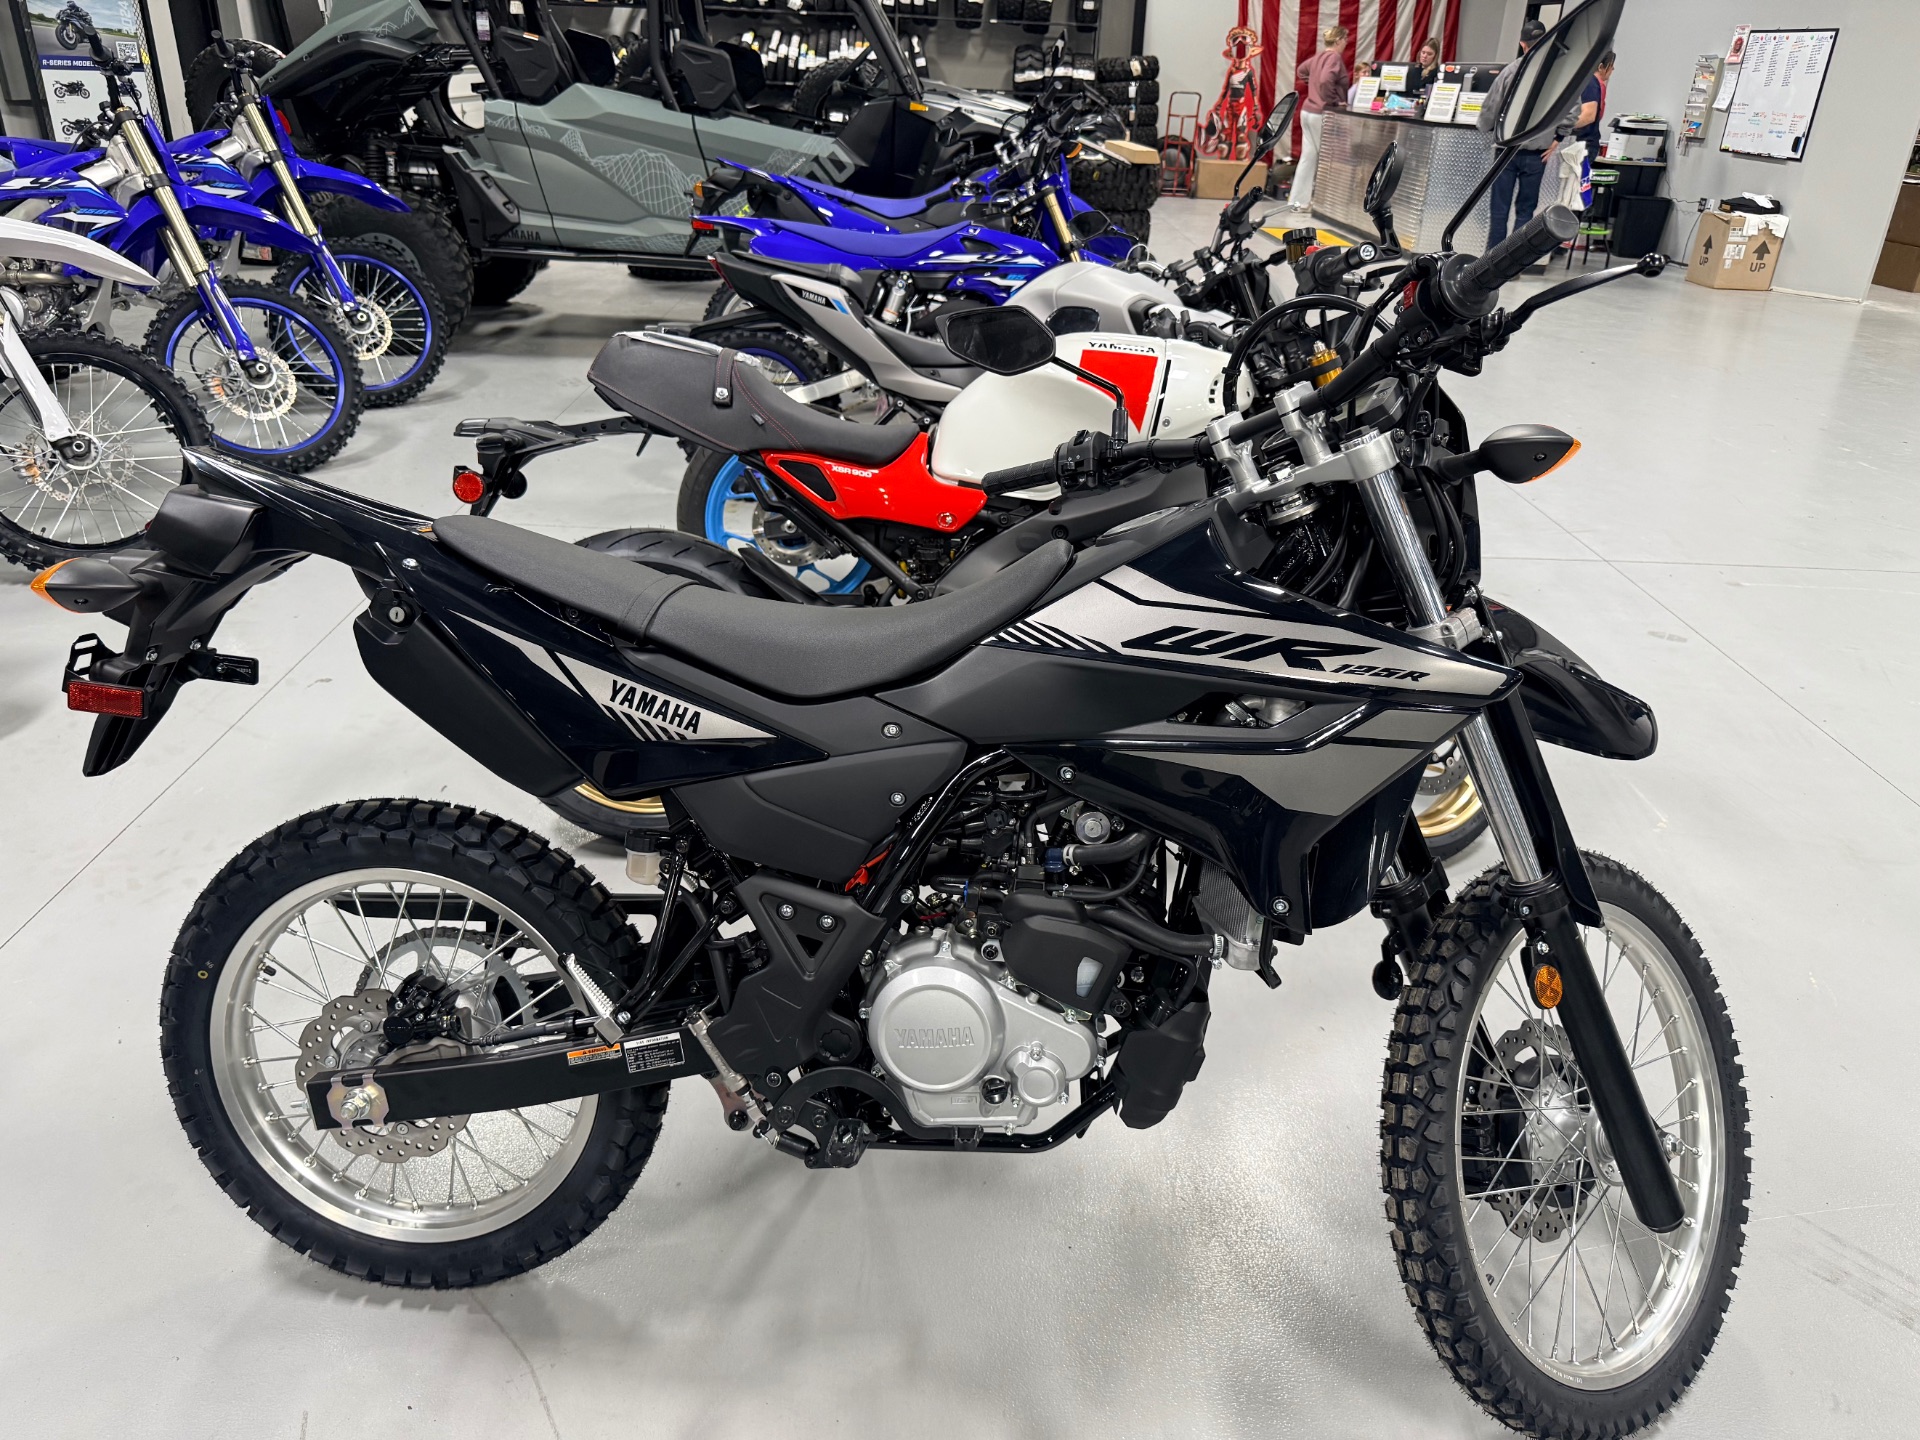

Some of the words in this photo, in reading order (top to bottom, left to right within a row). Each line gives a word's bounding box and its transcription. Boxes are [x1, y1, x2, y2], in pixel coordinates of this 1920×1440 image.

[42, 59, 72, 67] R-SERIES
[1698, 255, 1709, 267] UP
[1749, 262, 1766, 273] UP
[801, 289, 827, 305] YAMAHA
[831, 464, 852, 475] XSR
[851, 468, 873, 478] 900
[1120, 625, 1383, 672] WR
[1329, 663, 1431, 682] 125R
[609, 679, 701, 735] YAMAHA
[894, 1026, 975, 1049] YAMAHA
